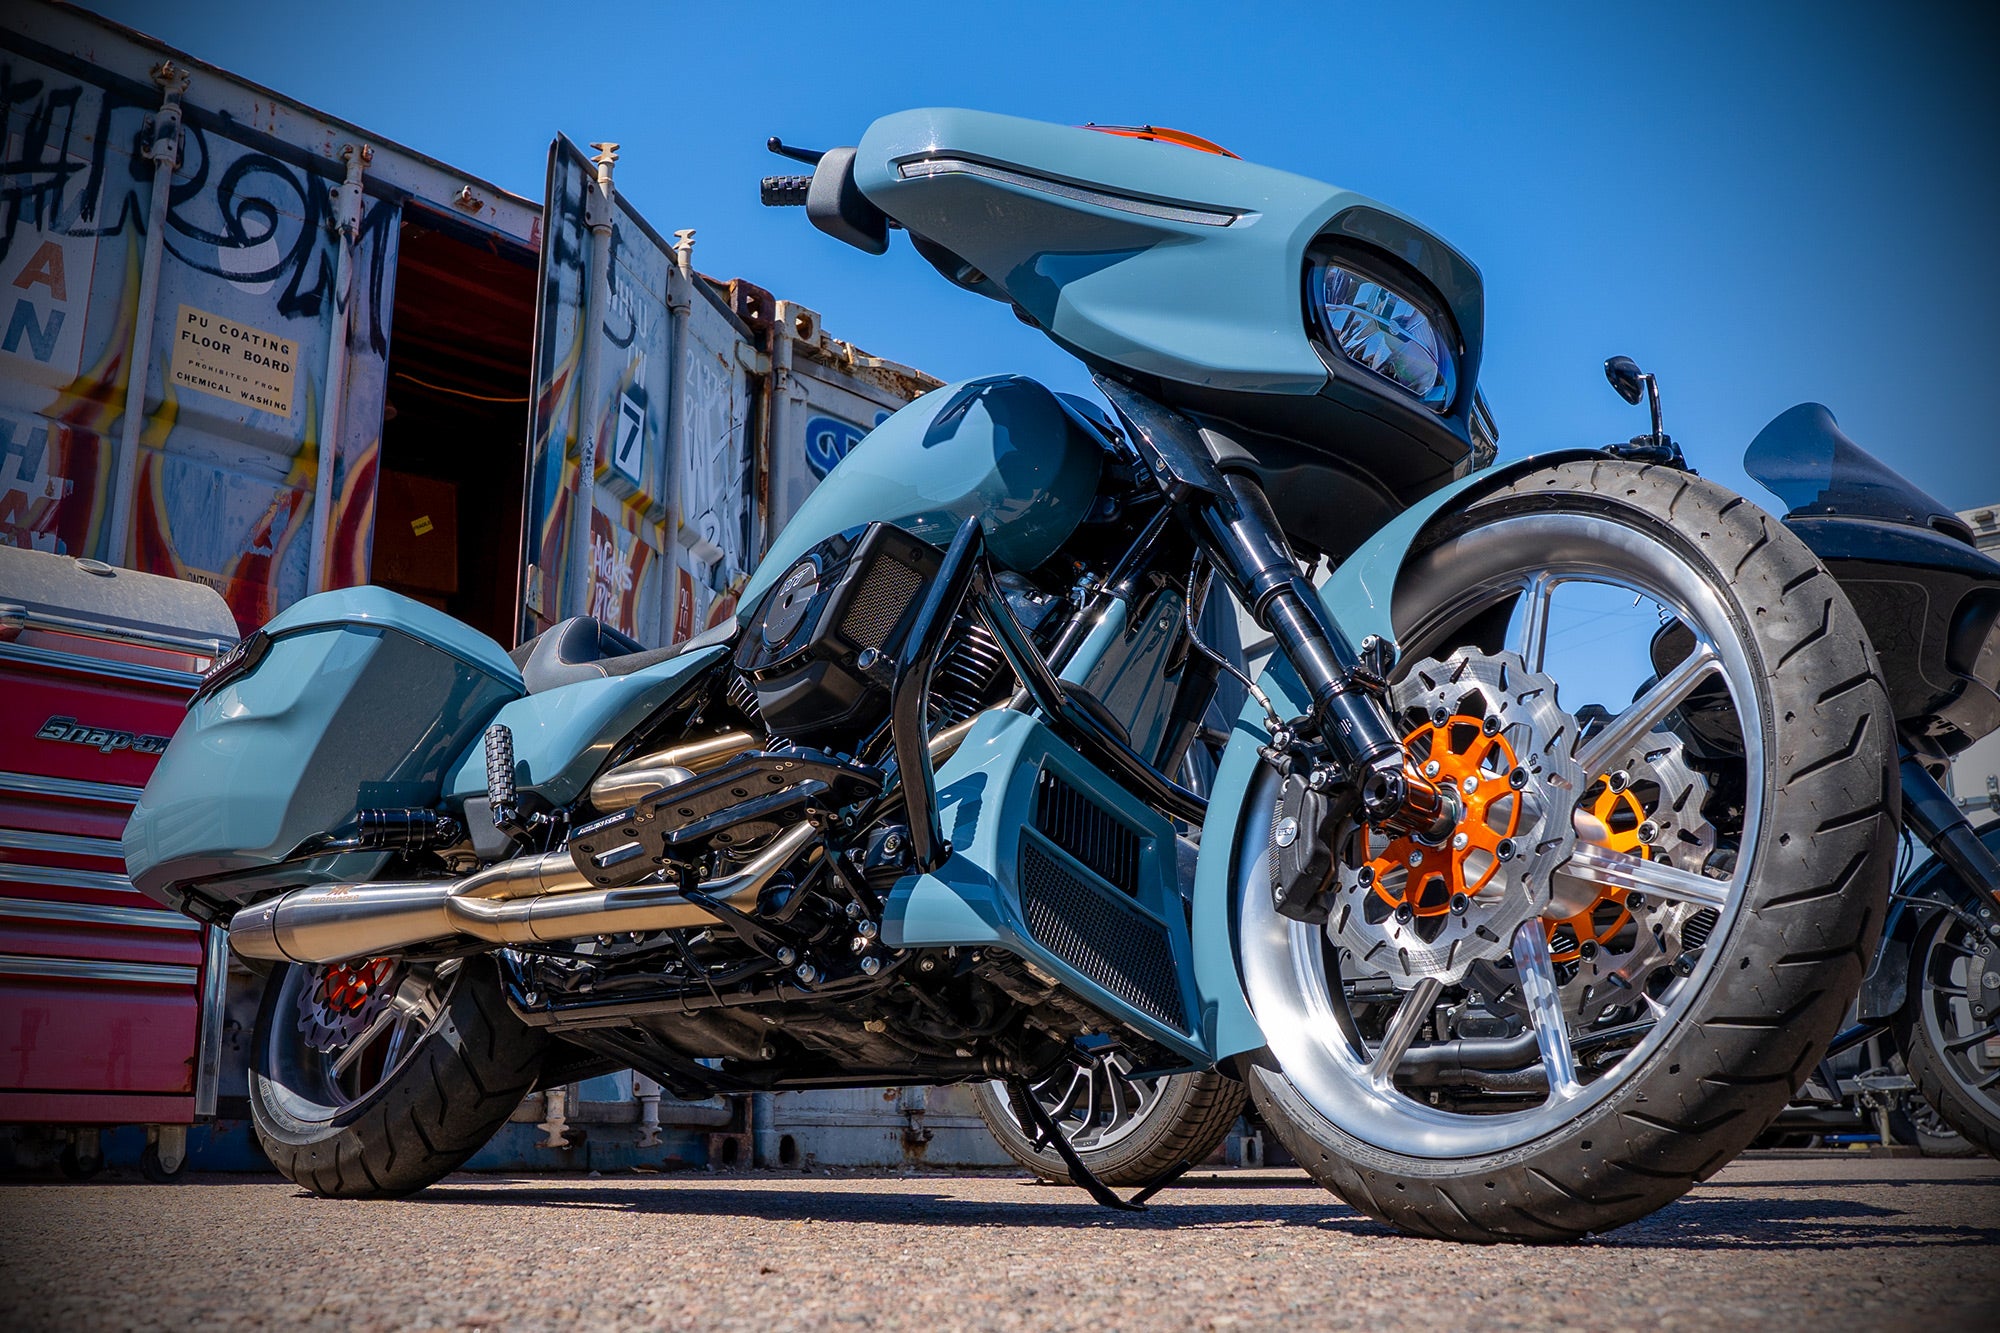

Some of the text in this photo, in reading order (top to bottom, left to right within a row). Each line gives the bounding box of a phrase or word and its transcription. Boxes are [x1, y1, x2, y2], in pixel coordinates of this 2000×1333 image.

[181, 330, 290, 373] FLOOR BOARD
[187, 312, 290, 356] PU COATING
[176, 371, 288, 412] CHEMICAL WASHING
[187, 359, 281, 393] PROHIBITED FROM
[619, 401, 641, 464] 7
